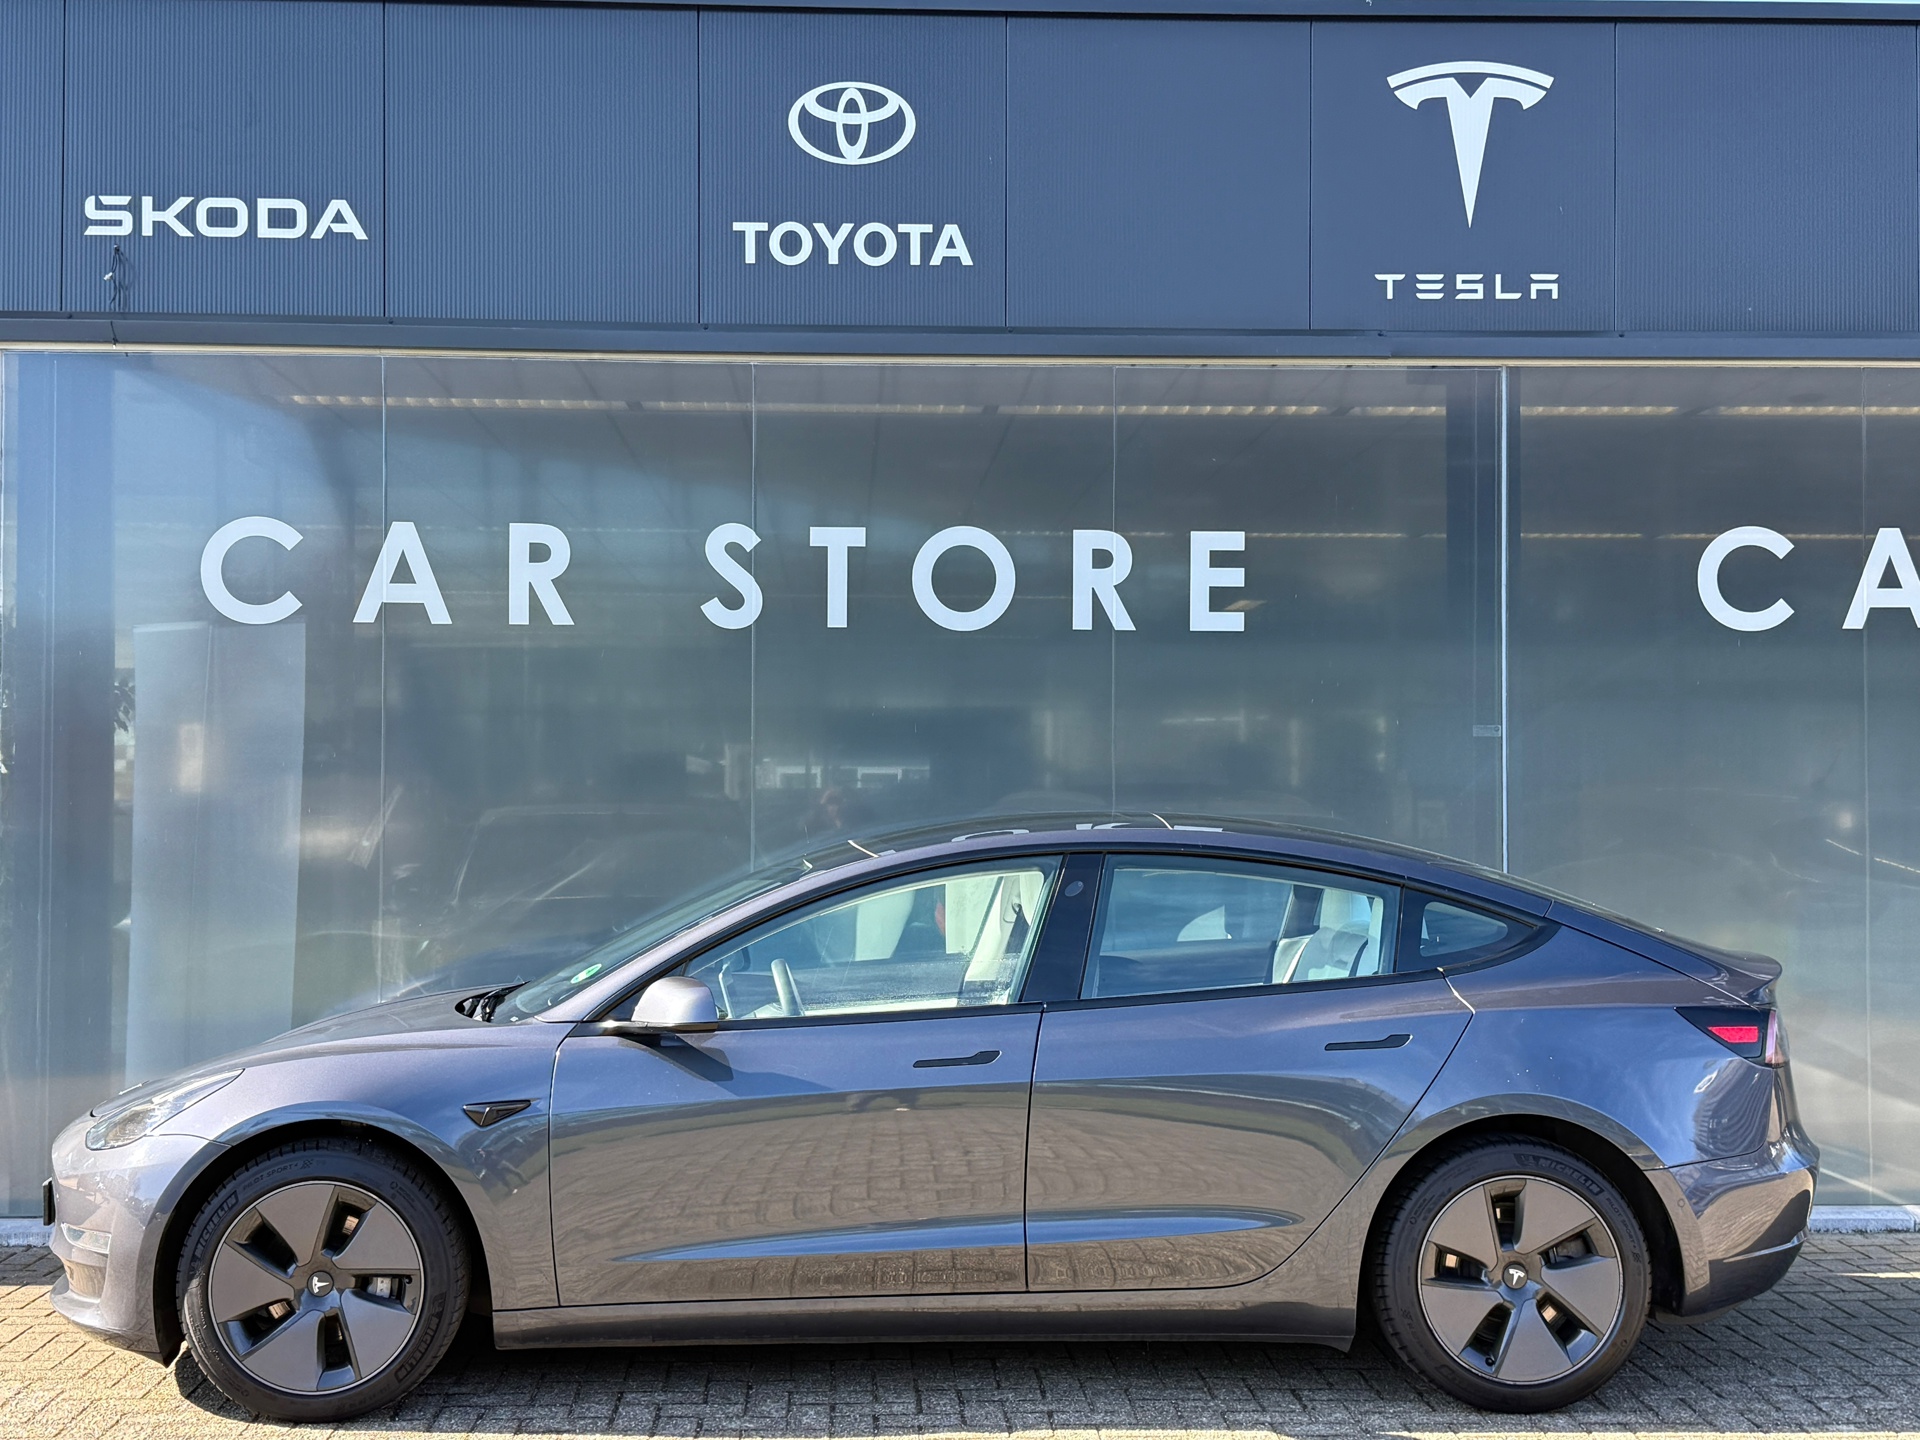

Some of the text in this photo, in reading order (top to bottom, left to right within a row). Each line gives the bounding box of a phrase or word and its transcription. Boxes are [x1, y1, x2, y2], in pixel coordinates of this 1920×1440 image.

[732, 221, 974, 267] TOYOTA
[1374, 273, 1560, 300] TESLA
[199, 515, 1246, 632] CAR STORE
[242, 1174, 265, 1190] PILOT
[1537, 1157, 1602, 1194] MICHELIN
[1605, 1196, 1622, 1217] PILOT
[194, 1193, 238, 1260] MICHELIN
